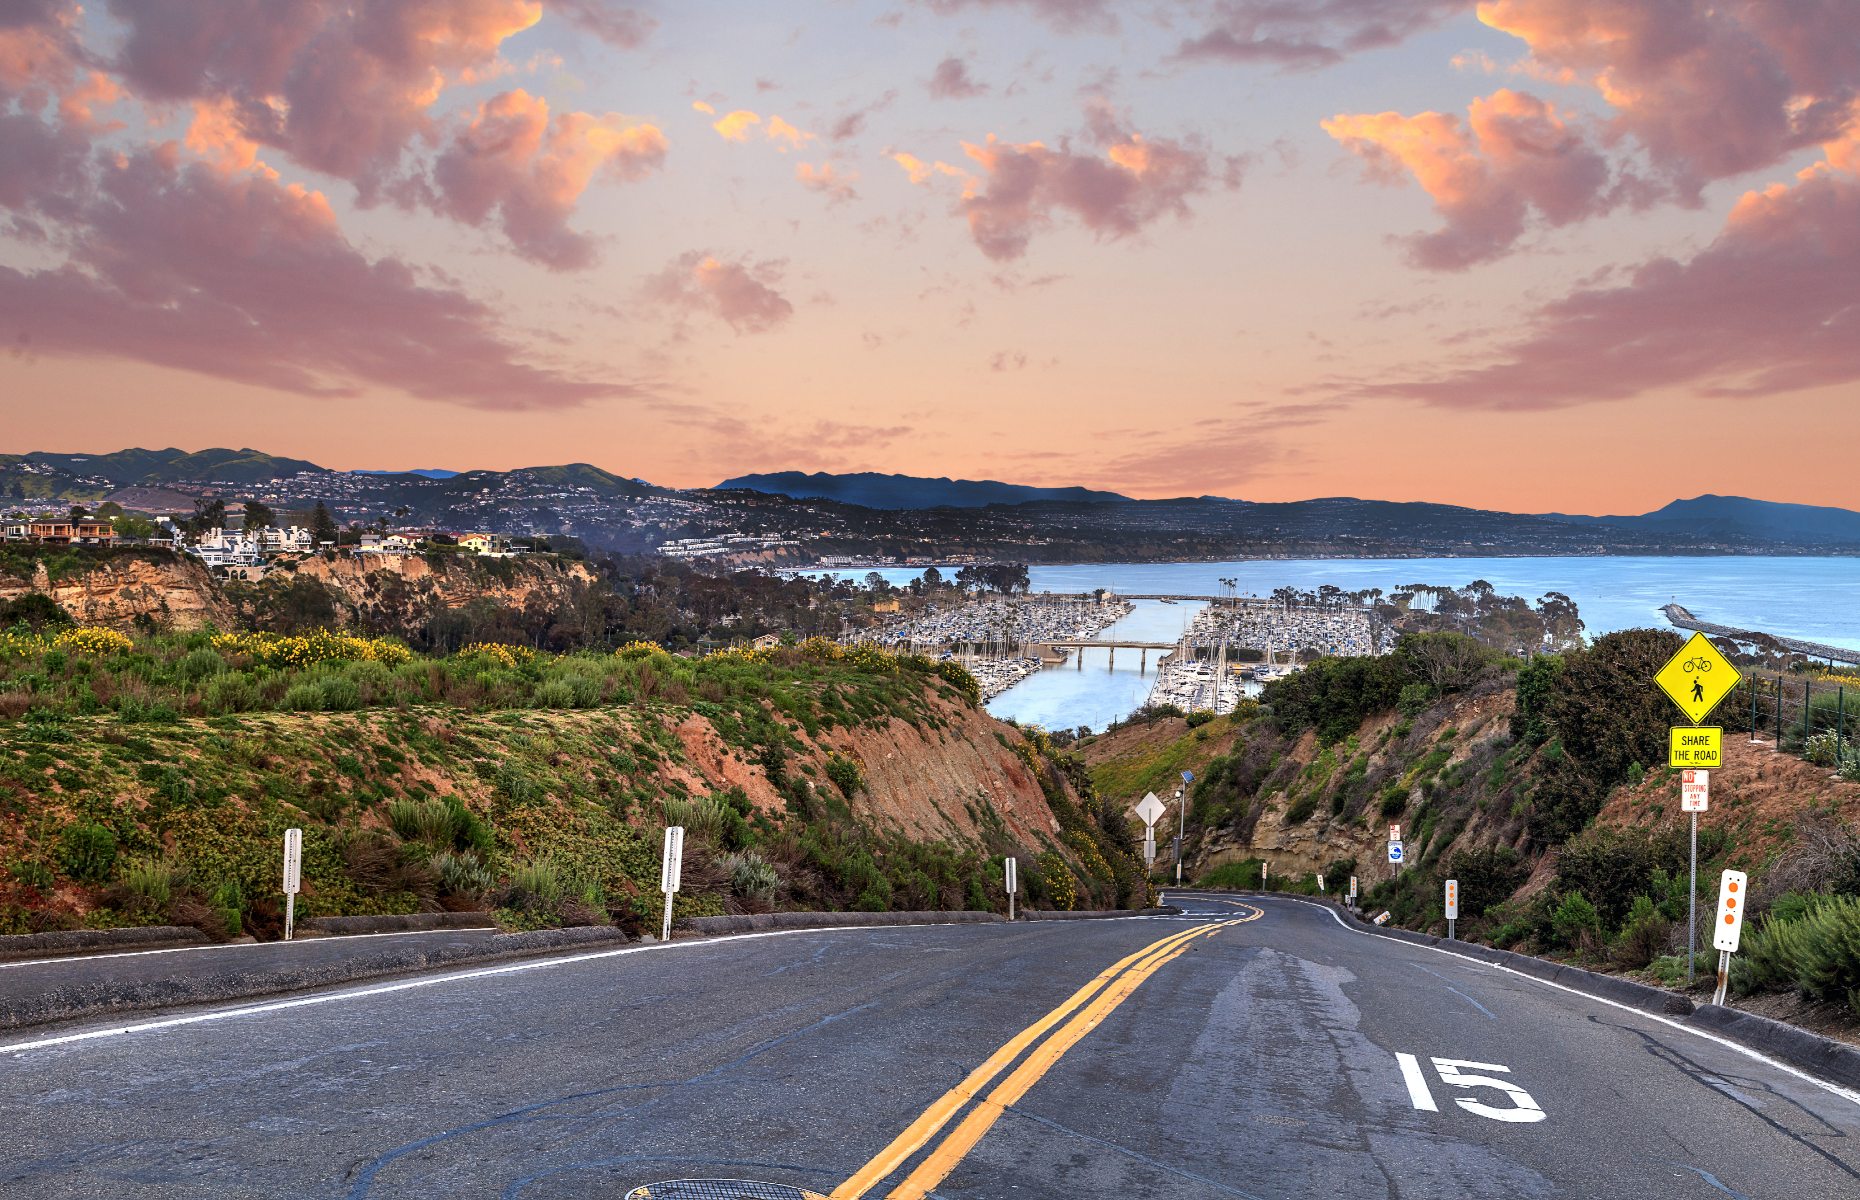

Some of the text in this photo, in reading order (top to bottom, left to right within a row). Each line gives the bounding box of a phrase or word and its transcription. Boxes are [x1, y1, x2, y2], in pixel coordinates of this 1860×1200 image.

[1681, 735, 1710, 746] SHARE
[1674, 750, 1717, 761] THE ROAD
[1683, 772, 1694, 782] NO
[1684, 784, 1707, 793] STOPPING
[1394, 1051, 1548, 1123] 15
